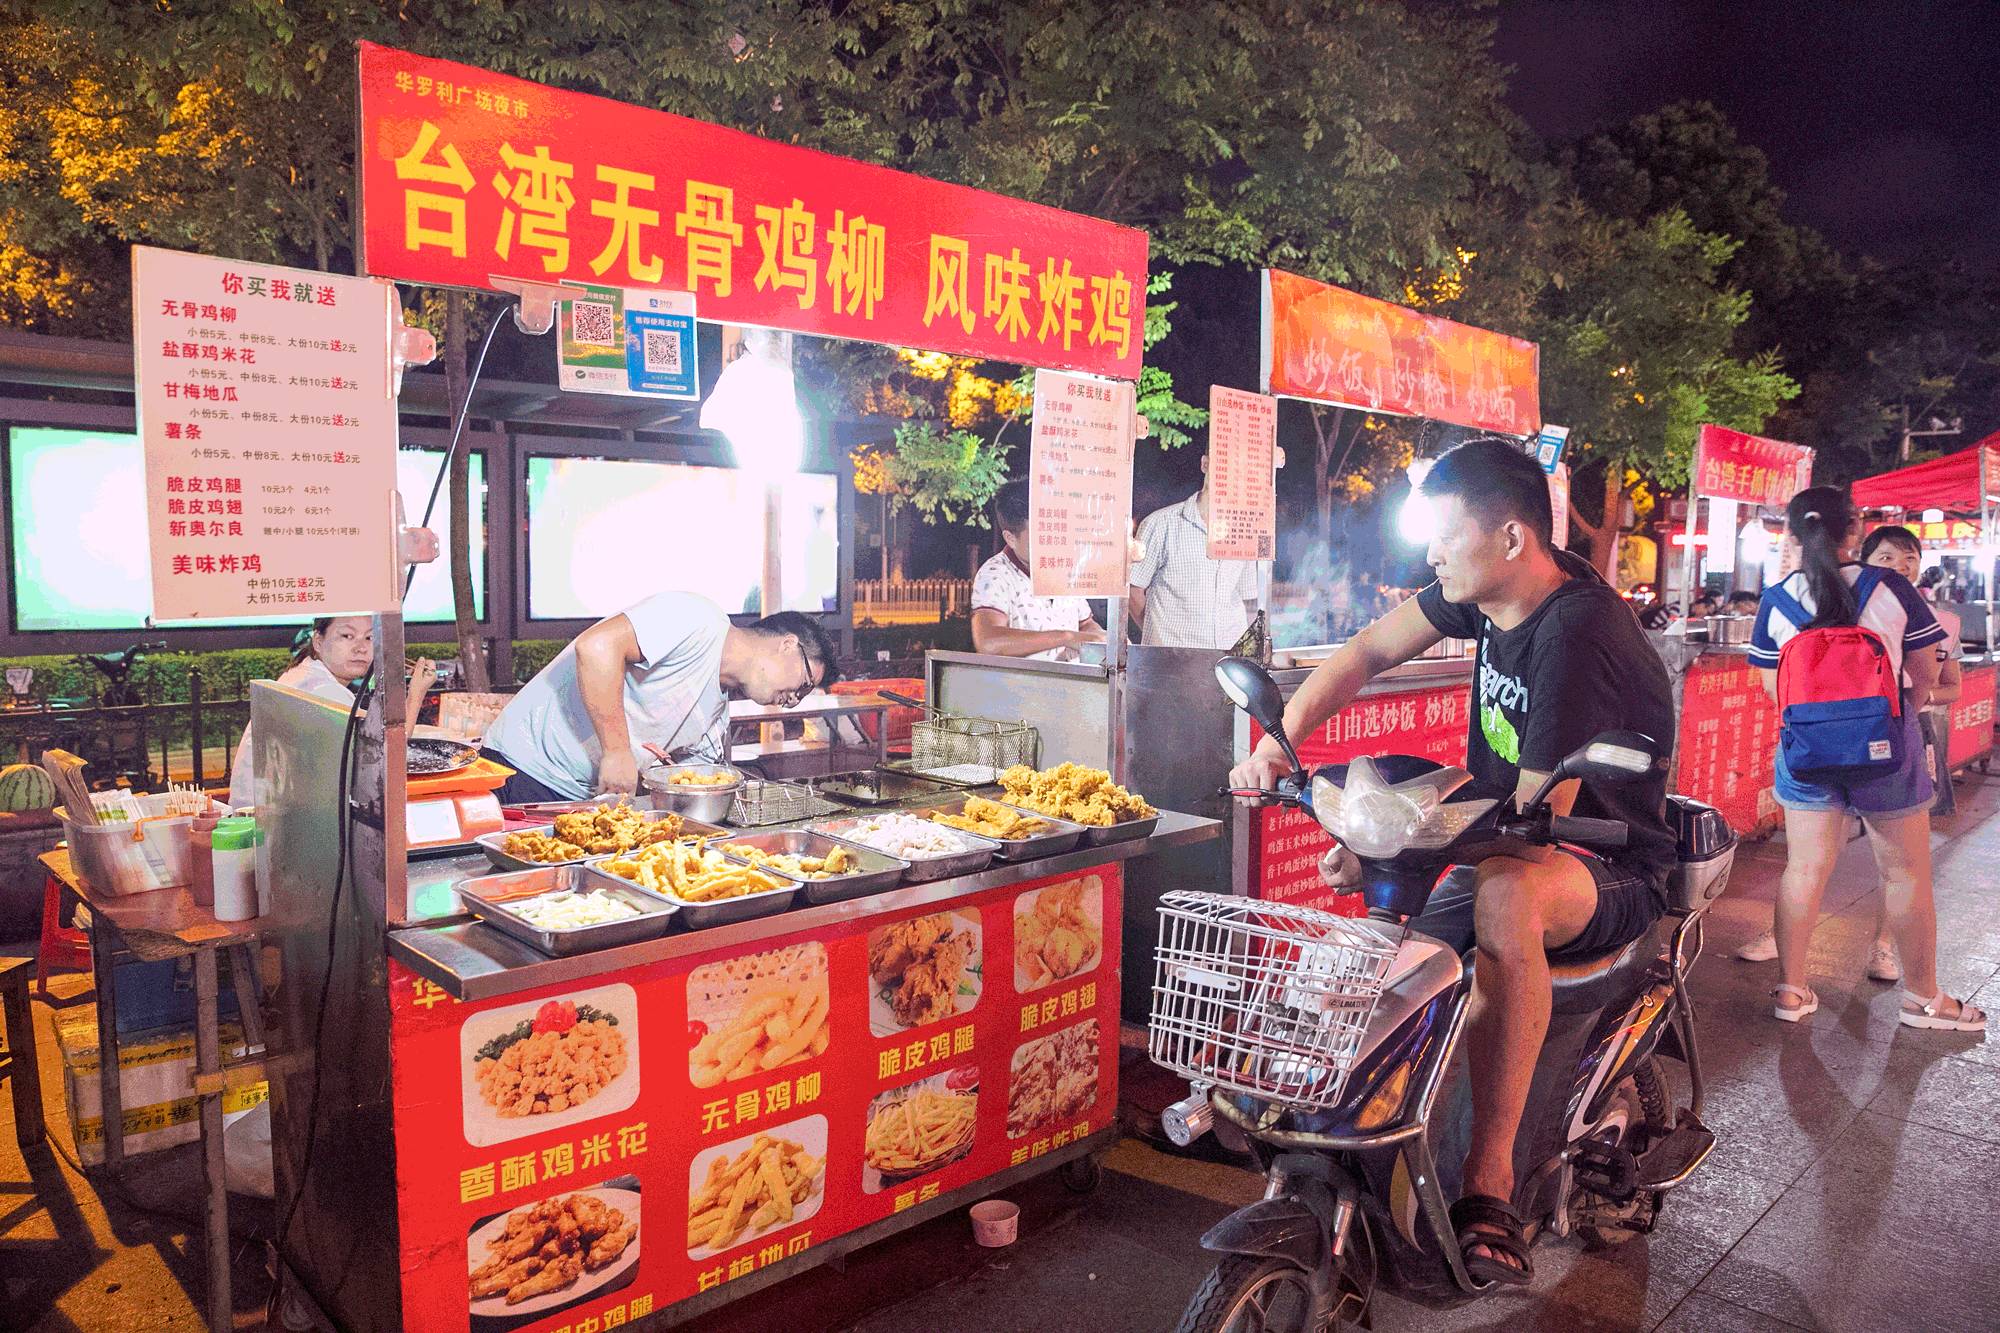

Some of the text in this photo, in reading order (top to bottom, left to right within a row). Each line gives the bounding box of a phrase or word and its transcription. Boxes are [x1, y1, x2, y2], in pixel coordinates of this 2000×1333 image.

[395, 71, 529, 119] 华罗利广场夜市
[394, 120, 1132, 360] 台湾无骨鸡柳 风味炸鸡
[221, 272, 336, 306] 你买我就送
[161, 299, 237, 324] 无骨鸡柳
[162, 340, 257, 365] 盐酥鸡米花
[163, 381, 239, 402] 甘梅地瓜
[164, 422, 202, 440] 薯条
[166, 476, 331, 495] 脆皮鸡腿 10元3个 4元1个
[167, 498, 332, 516] 脆皮鸡翅 10元2个 6元1个
[169, 520, 244, 537] 新奥尔良
[172, 554, 262, 576] 美味炸鸡
[247, 577, 326, 590] 中份10元送2元
[247, 591, 326, 605] 大份15元送5元
[1325, 700, 1417, 745] 自由选炒饭
[1424, 693, 1457, 728] 炒粉
[1020, 982, 1097, 1033] 脆皮鸡翅
[877, 1023, 976, 1081] 脆皮鸡腿
[701, 1071, 822, 1135] 无骨鸡柳
[459, 1121, 649, 1204] 香酥鸡米花
